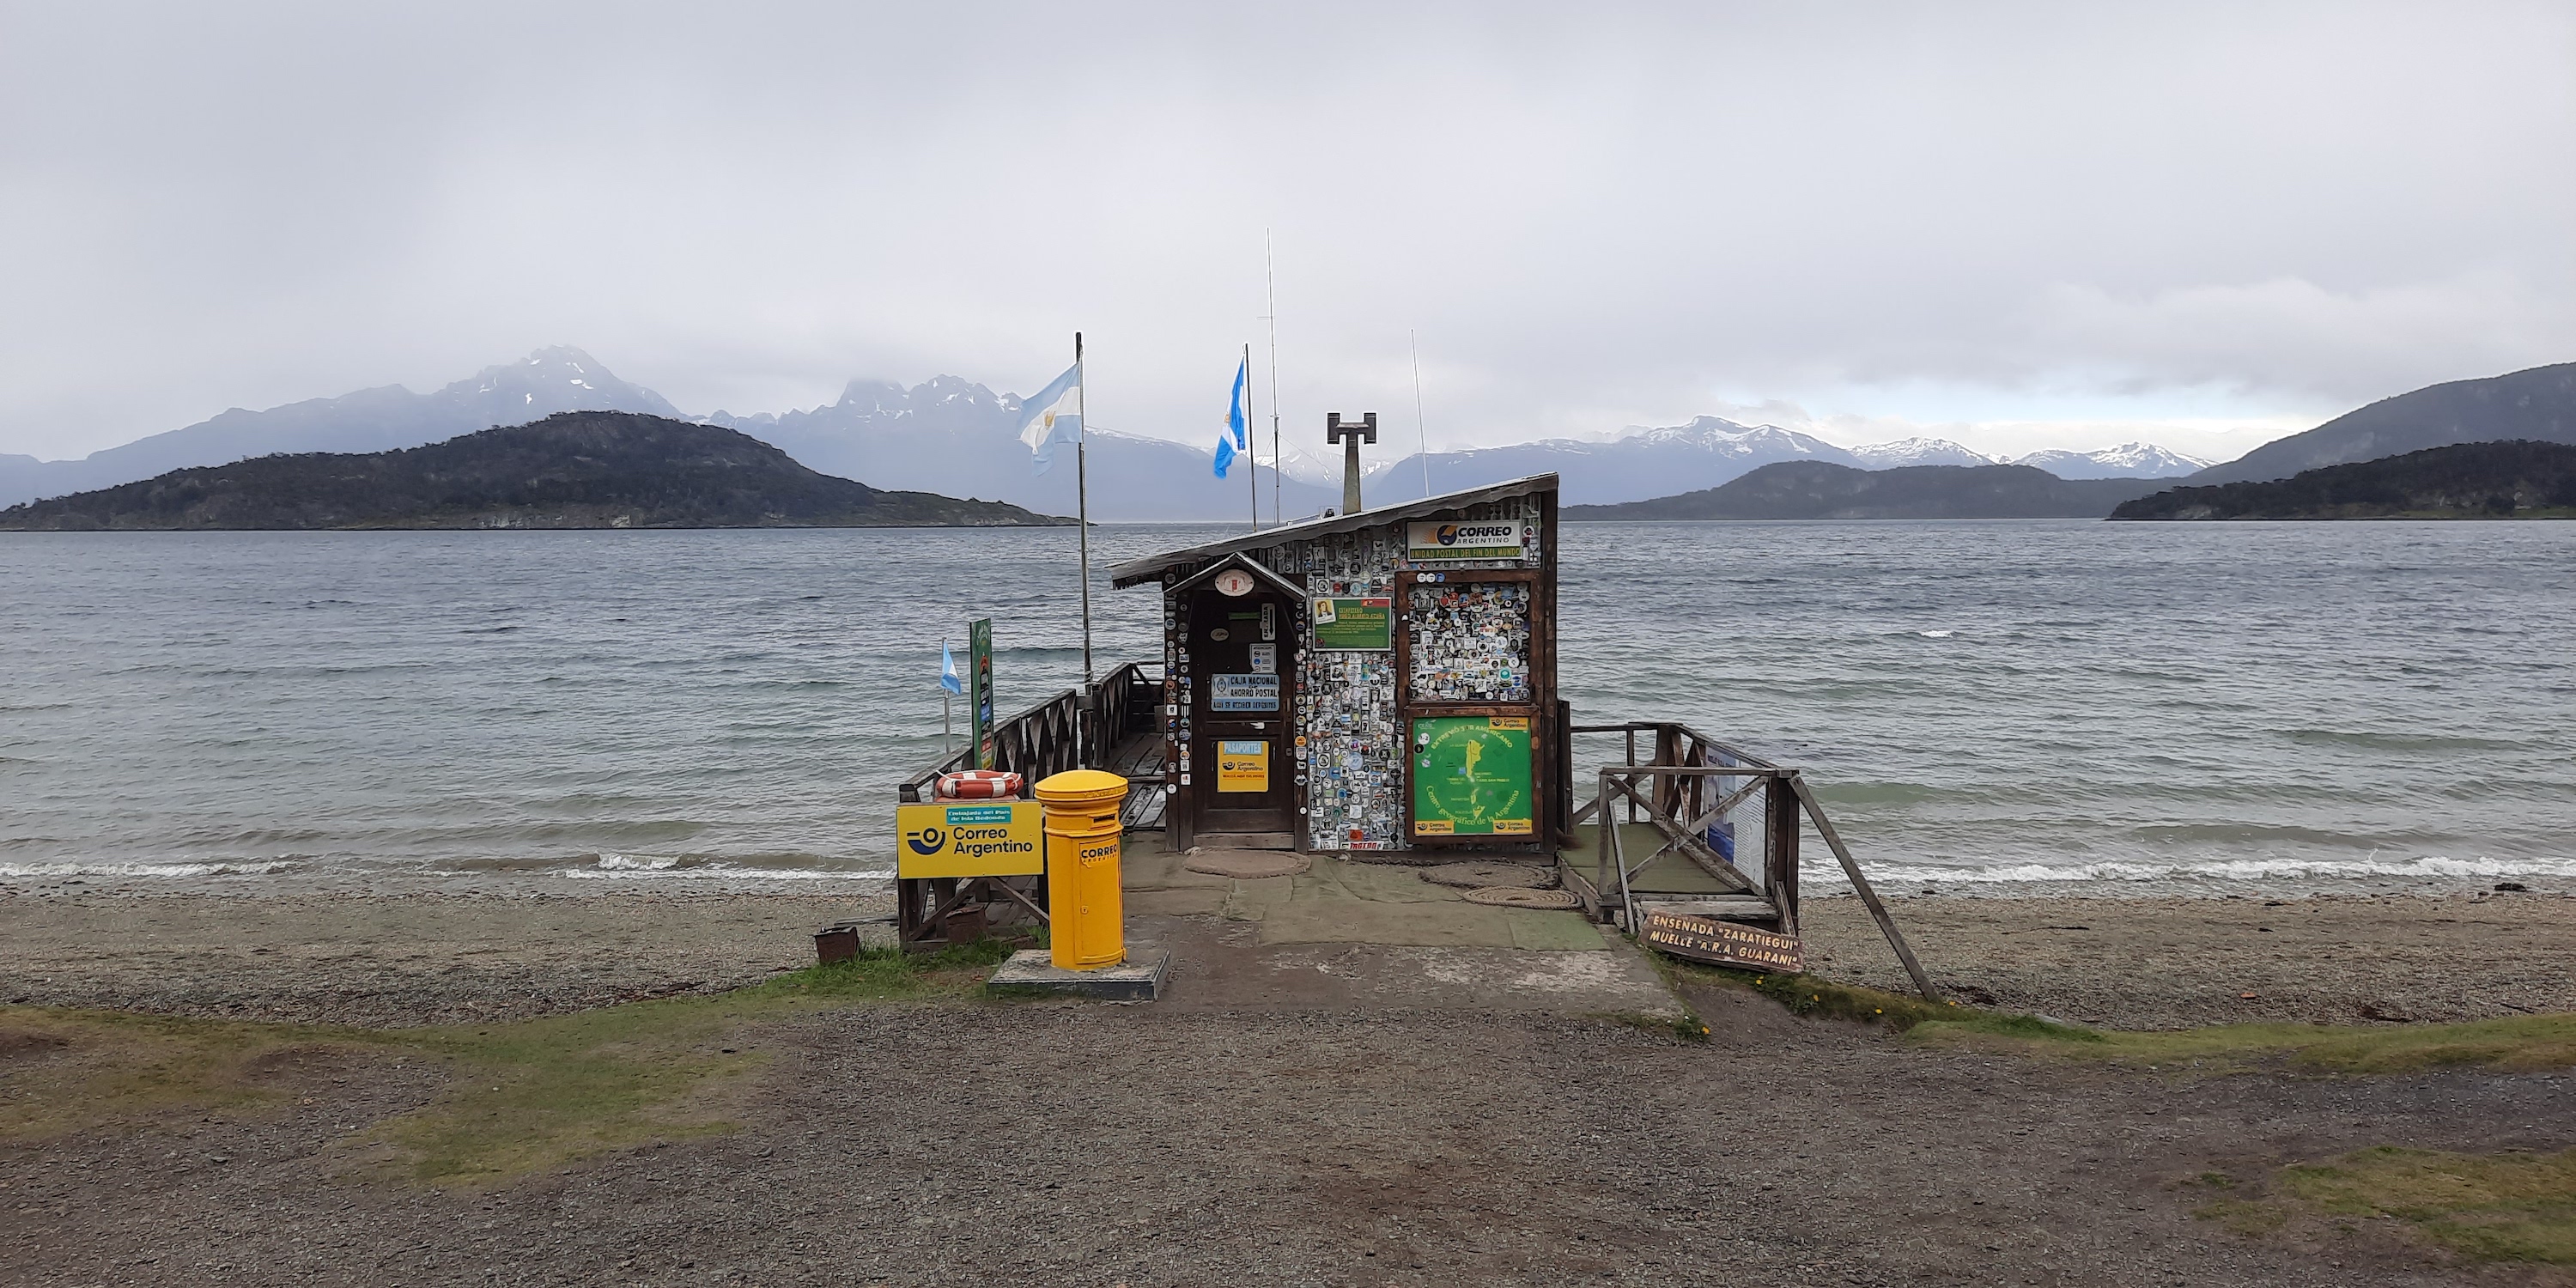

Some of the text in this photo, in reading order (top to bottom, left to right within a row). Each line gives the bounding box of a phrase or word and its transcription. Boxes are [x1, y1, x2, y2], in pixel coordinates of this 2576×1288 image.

[1458, 526, 1512, 537] CORREO
[1436, 550, 1458, 558] POSTAL
[1497, 548, 1520, 556] MUNDO
[1230, 677, 1278, 685] CAJA NACIONAL
[1230, 689, 1278, 697] AHORRO POSTAL
[1224, 742, 1261, 754] PASAPORTES
[1426, 785, 1441, 809] Centro
[1495, 790, 1519, 819] Argentina
[953, 827, 1007, 840] Correo
[953, 840, 1033, 858] Argentino
[1081, 844, 1117, 859] CORREO
[1653, 915, 1799, 951] ENSENADA "ZARATIEGUI"
[1649, 930, 1694, 949] MUELLE
[1697, 940, 1735, 956] "A.R.A.
